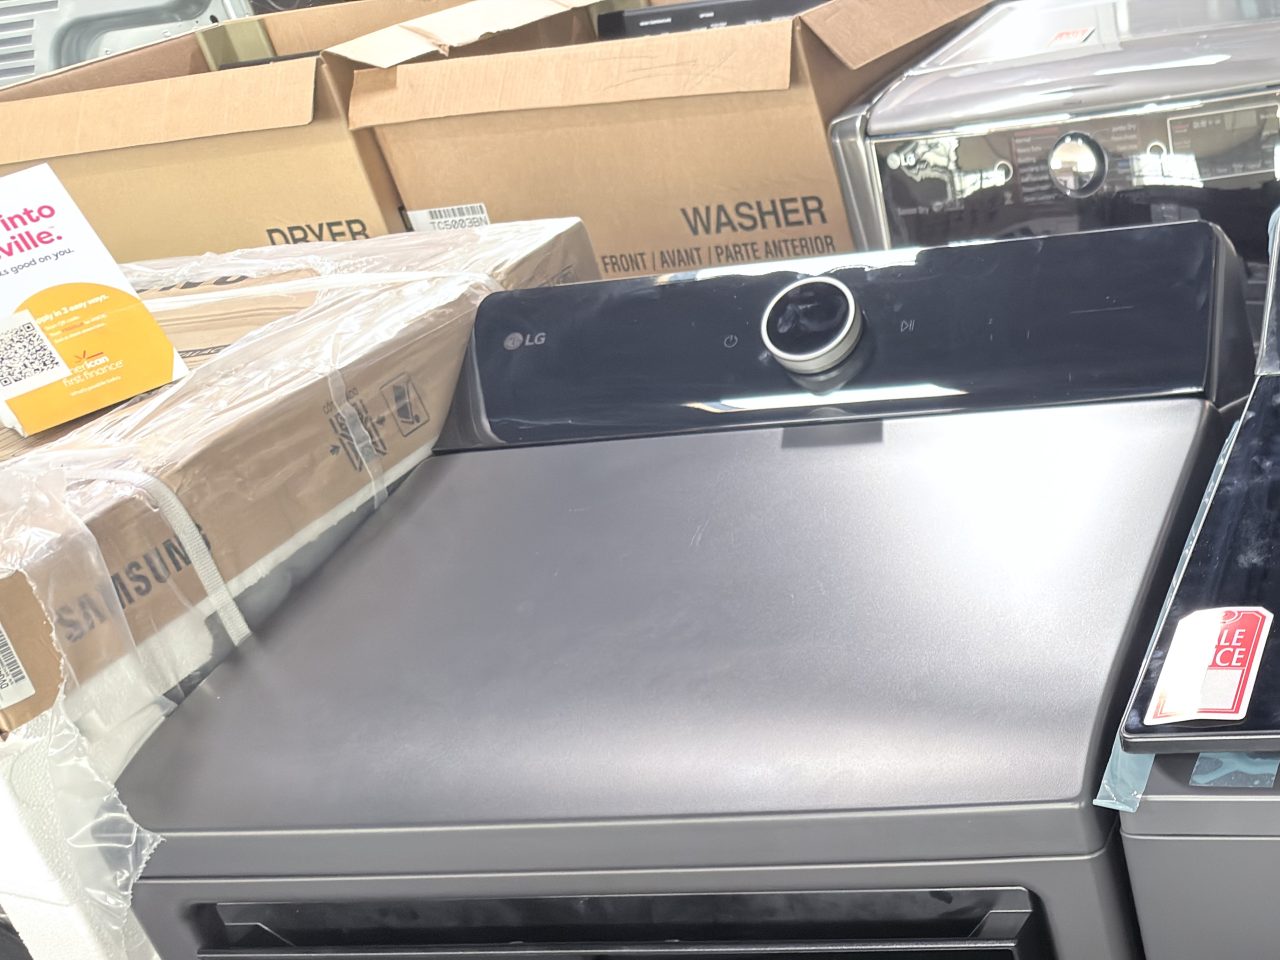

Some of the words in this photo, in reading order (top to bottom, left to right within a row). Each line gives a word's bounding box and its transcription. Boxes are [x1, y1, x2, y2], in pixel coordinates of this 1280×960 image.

[0, 205, 56, 231] into
[681, 195, 828, 236] WASHER
[0, 231, 63, 257] ville.
[267, 218, 371, 246] DRYER
[10, 257, 37, 274] good
[38, 255, 52, 263] on
[52, 248, 75, 260] you.
[601, 252, 648, 273] FRONT
[660, 246, 702, 269] AVANT
[715, 241, 759, 264] PARTE
[764, 235, 836, 260] ANTERIOR
[56, 523, 212, 643] SAMSUN
[1218, 628, 1246, 646] LE
